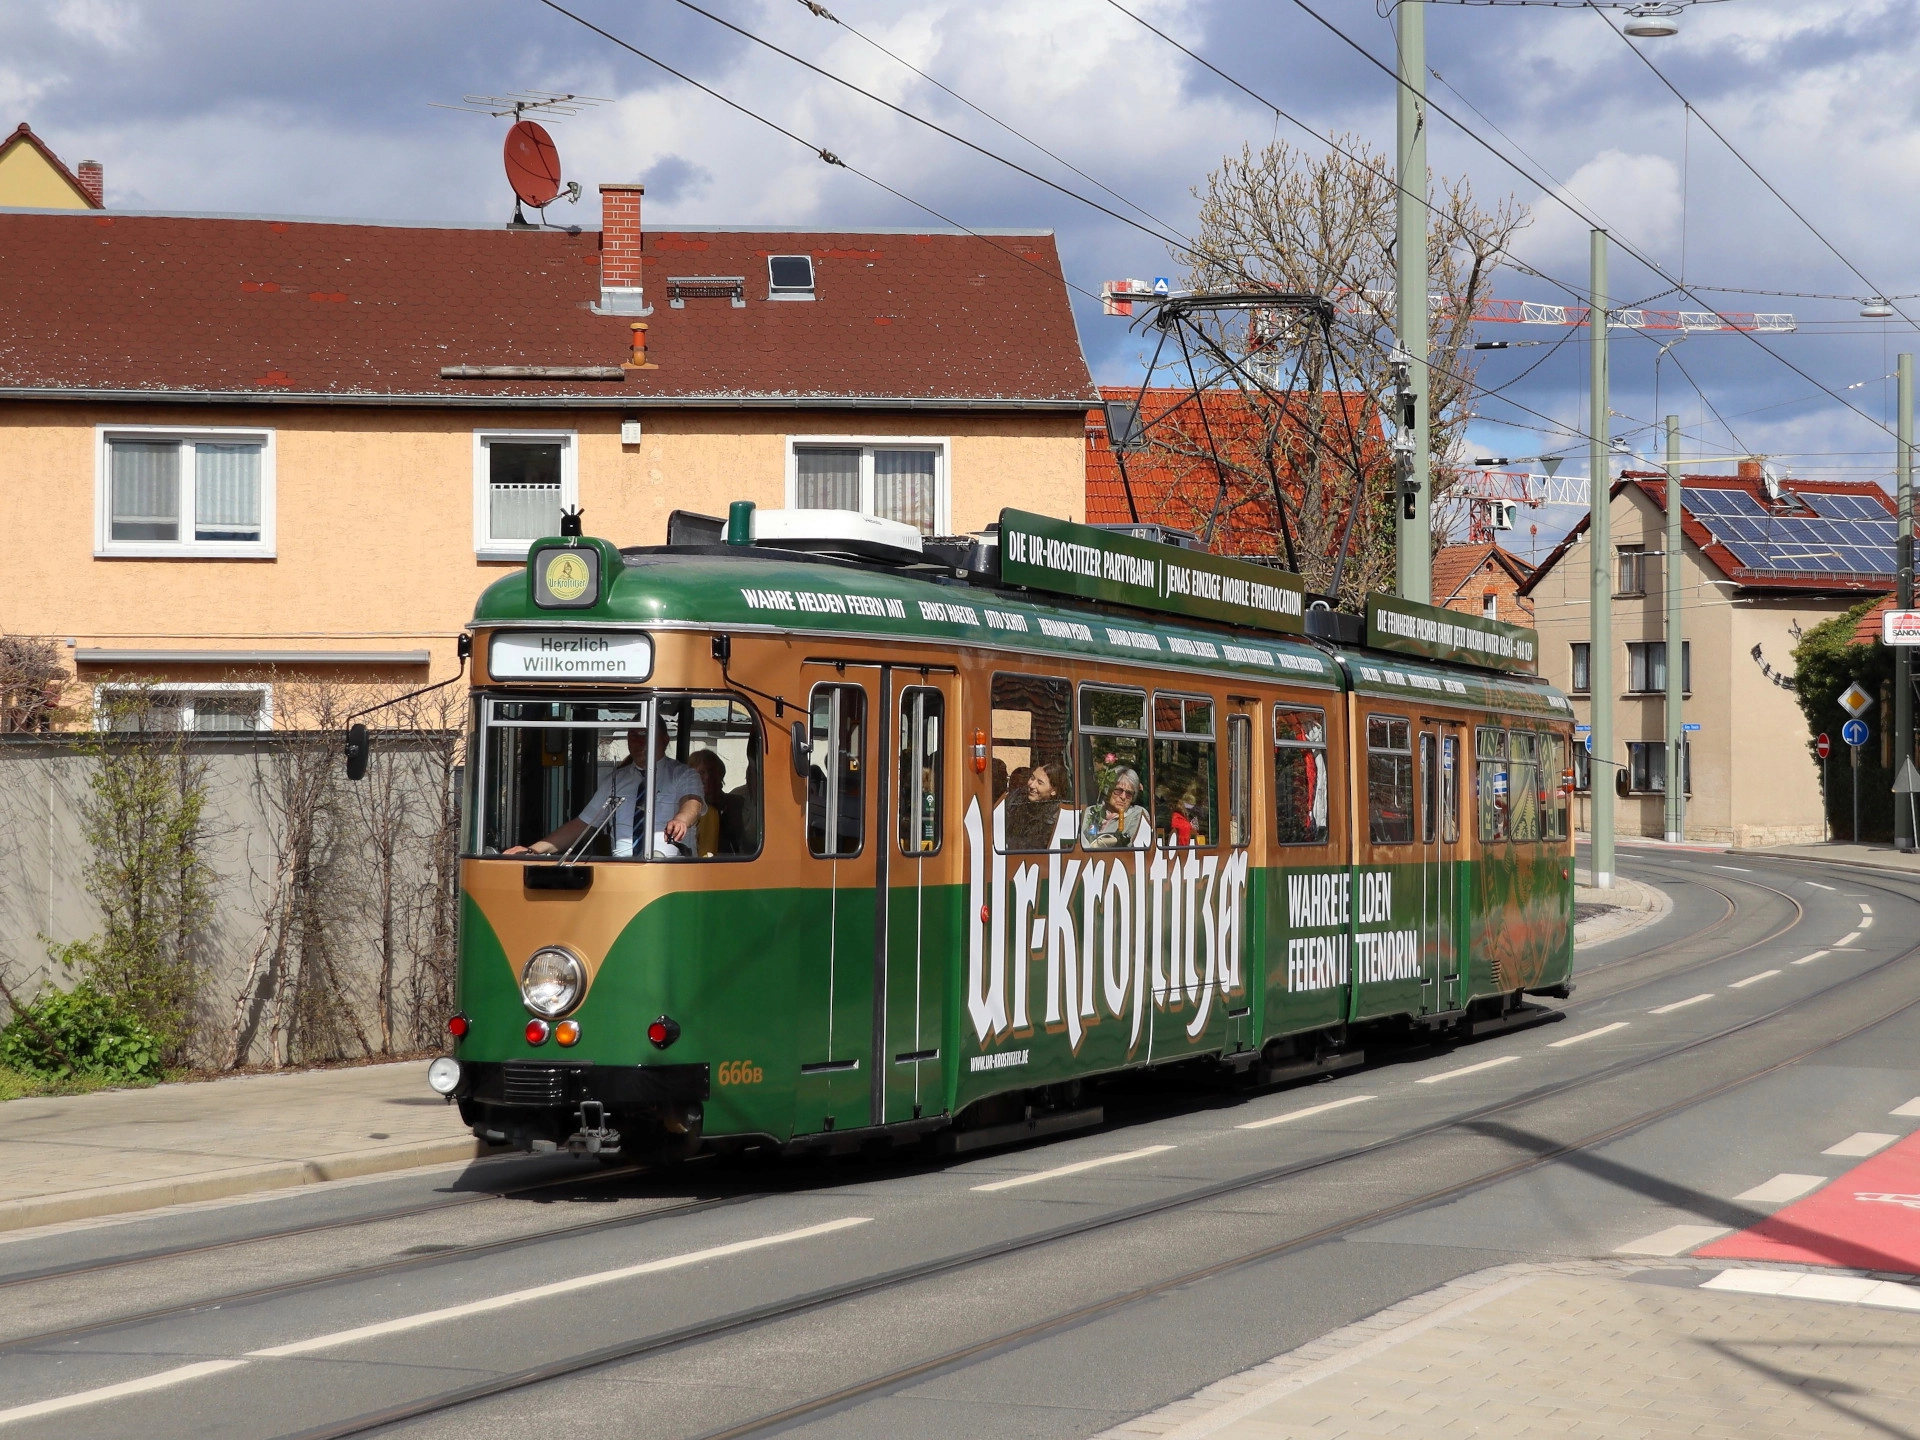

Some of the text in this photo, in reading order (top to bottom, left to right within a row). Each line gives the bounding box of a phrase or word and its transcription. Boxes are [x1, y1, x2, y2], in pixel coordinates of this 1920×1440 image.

[1008, 530, 1155, 588] DIE UR-KROSTITZER PARTYBAHN
[741, 588, 907, 619] WAHRE HELDEN FEIERN MIT
[1166, 564, 1302, 617] JENAS EINZIGE MOBILE EVENTLOCATION
[918, 600, 980, 626] ERNST HAECKEL
[984, 609, 1029, 633] OTTO SCHOTT
[541, 637, 609, 652] Herzlich
[523, 656, 627, 672] Willkommen
[1287, 936, 1337, 993] FEIERN
